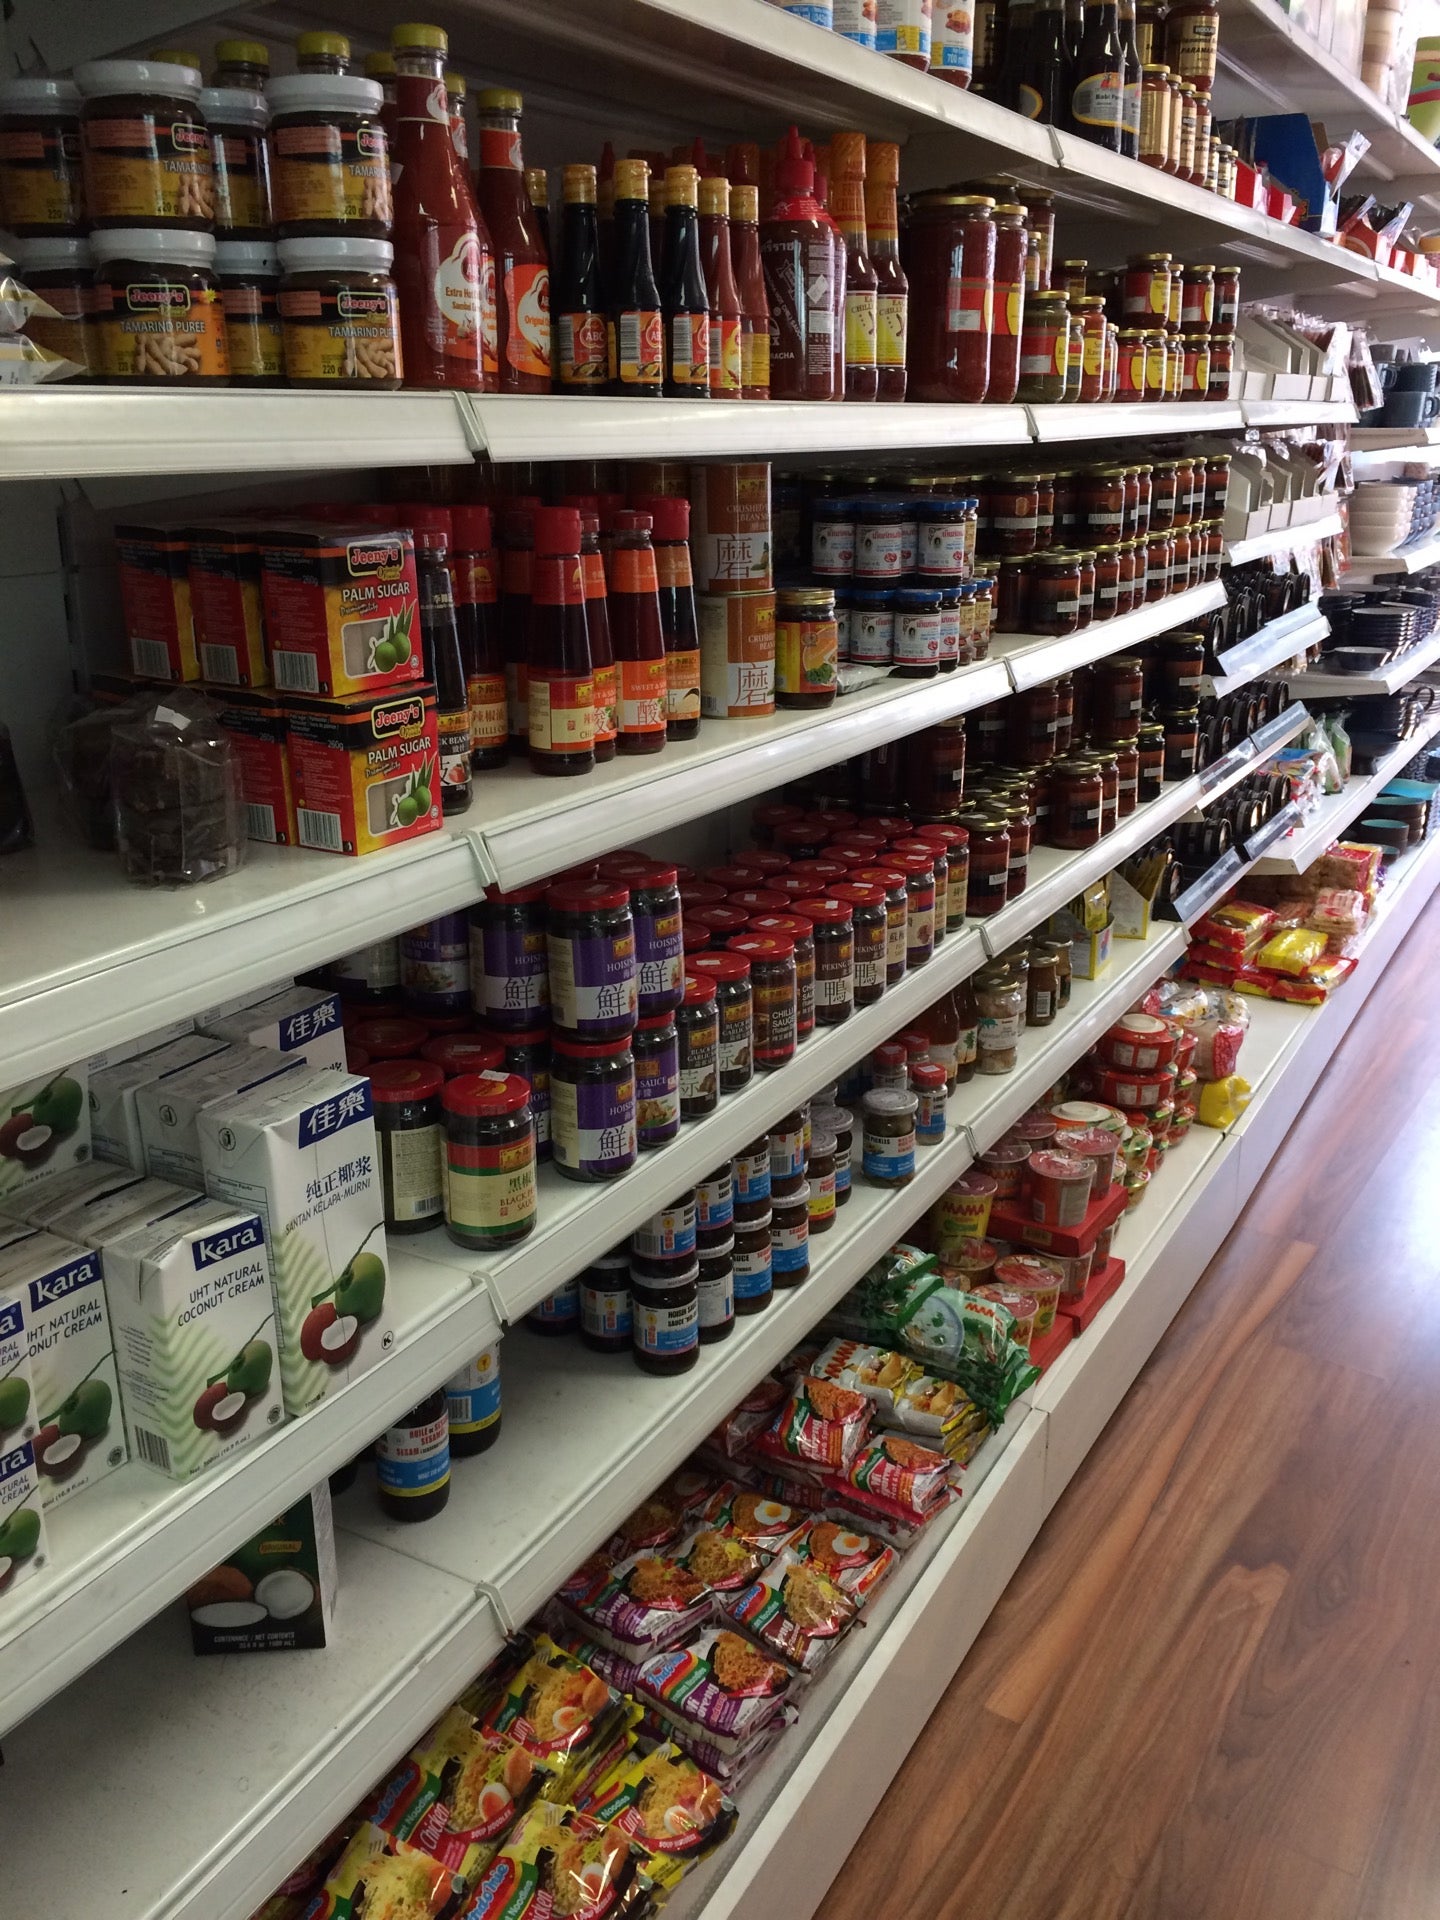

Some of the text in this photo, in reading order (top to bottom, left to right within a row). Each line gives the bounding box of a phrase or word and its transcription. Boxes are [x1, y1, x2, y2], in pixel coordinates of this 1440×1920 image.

[341, 298, 386, 310] Jeeny's
[445, 287, 463, 297] Extra
[120, 321, 205, 333] TAMARIND PUREE
[328, 326, 378, 338] TAMARIND
[585, 331, 604, 341] ABC
[351, 546, 398, 565] Jeeny's
[714, 534, 753, 579] 磨
[342, 581, 411, 602] PALM SUGAR
[734, 662, 769, 706] 磨
[375, 704, 420, 728] Jeeny's
[368, 736, 431, 764] PALM SUGAR
[649, 936, 677, 950] HOISIN
[503, 976, 535, 1009] 鮮
[639, 961, 668, 993] 鮮
[595, 983, 627, 1018] 鮮
[772, 1007, 794, 1019] CHILLI
[286, 1001, 336, 1041] 佳樂
[640, 1076, 666, 1088] SAUCE
[307, 1087, 366, 1136] 佳樂
[598, 1125, 627, 1159] 鮮
[305, 1155, 374, 1203] 纯正椰浆
[284, 1178, 372, 1236] SANTAN KELAPA-MURNI
[500, 1191, 526, 1207] BLACK
[942, 1201, 985, 1216] MAMA
[200, 1228, 257, 1262] kara
[35, 1263, 94, 1303] kara
[189, 1262, 264, 1304] UHT NATURAL
[49, 1298, 101, 1332] NATURAL
[177, 1275, 265, 1327] COCONUT CREAM
[29, 1312, 103, 1358] ONUT CREAM
[0, 1449, 27, 1477] ra
[1, 1483, 31, 1505] CREAM
[406, 1790, 435, 1824] Noodles
[600, 1795, 630, 1819] Noodles
[419, 1803, 451, 1850] Chicken
